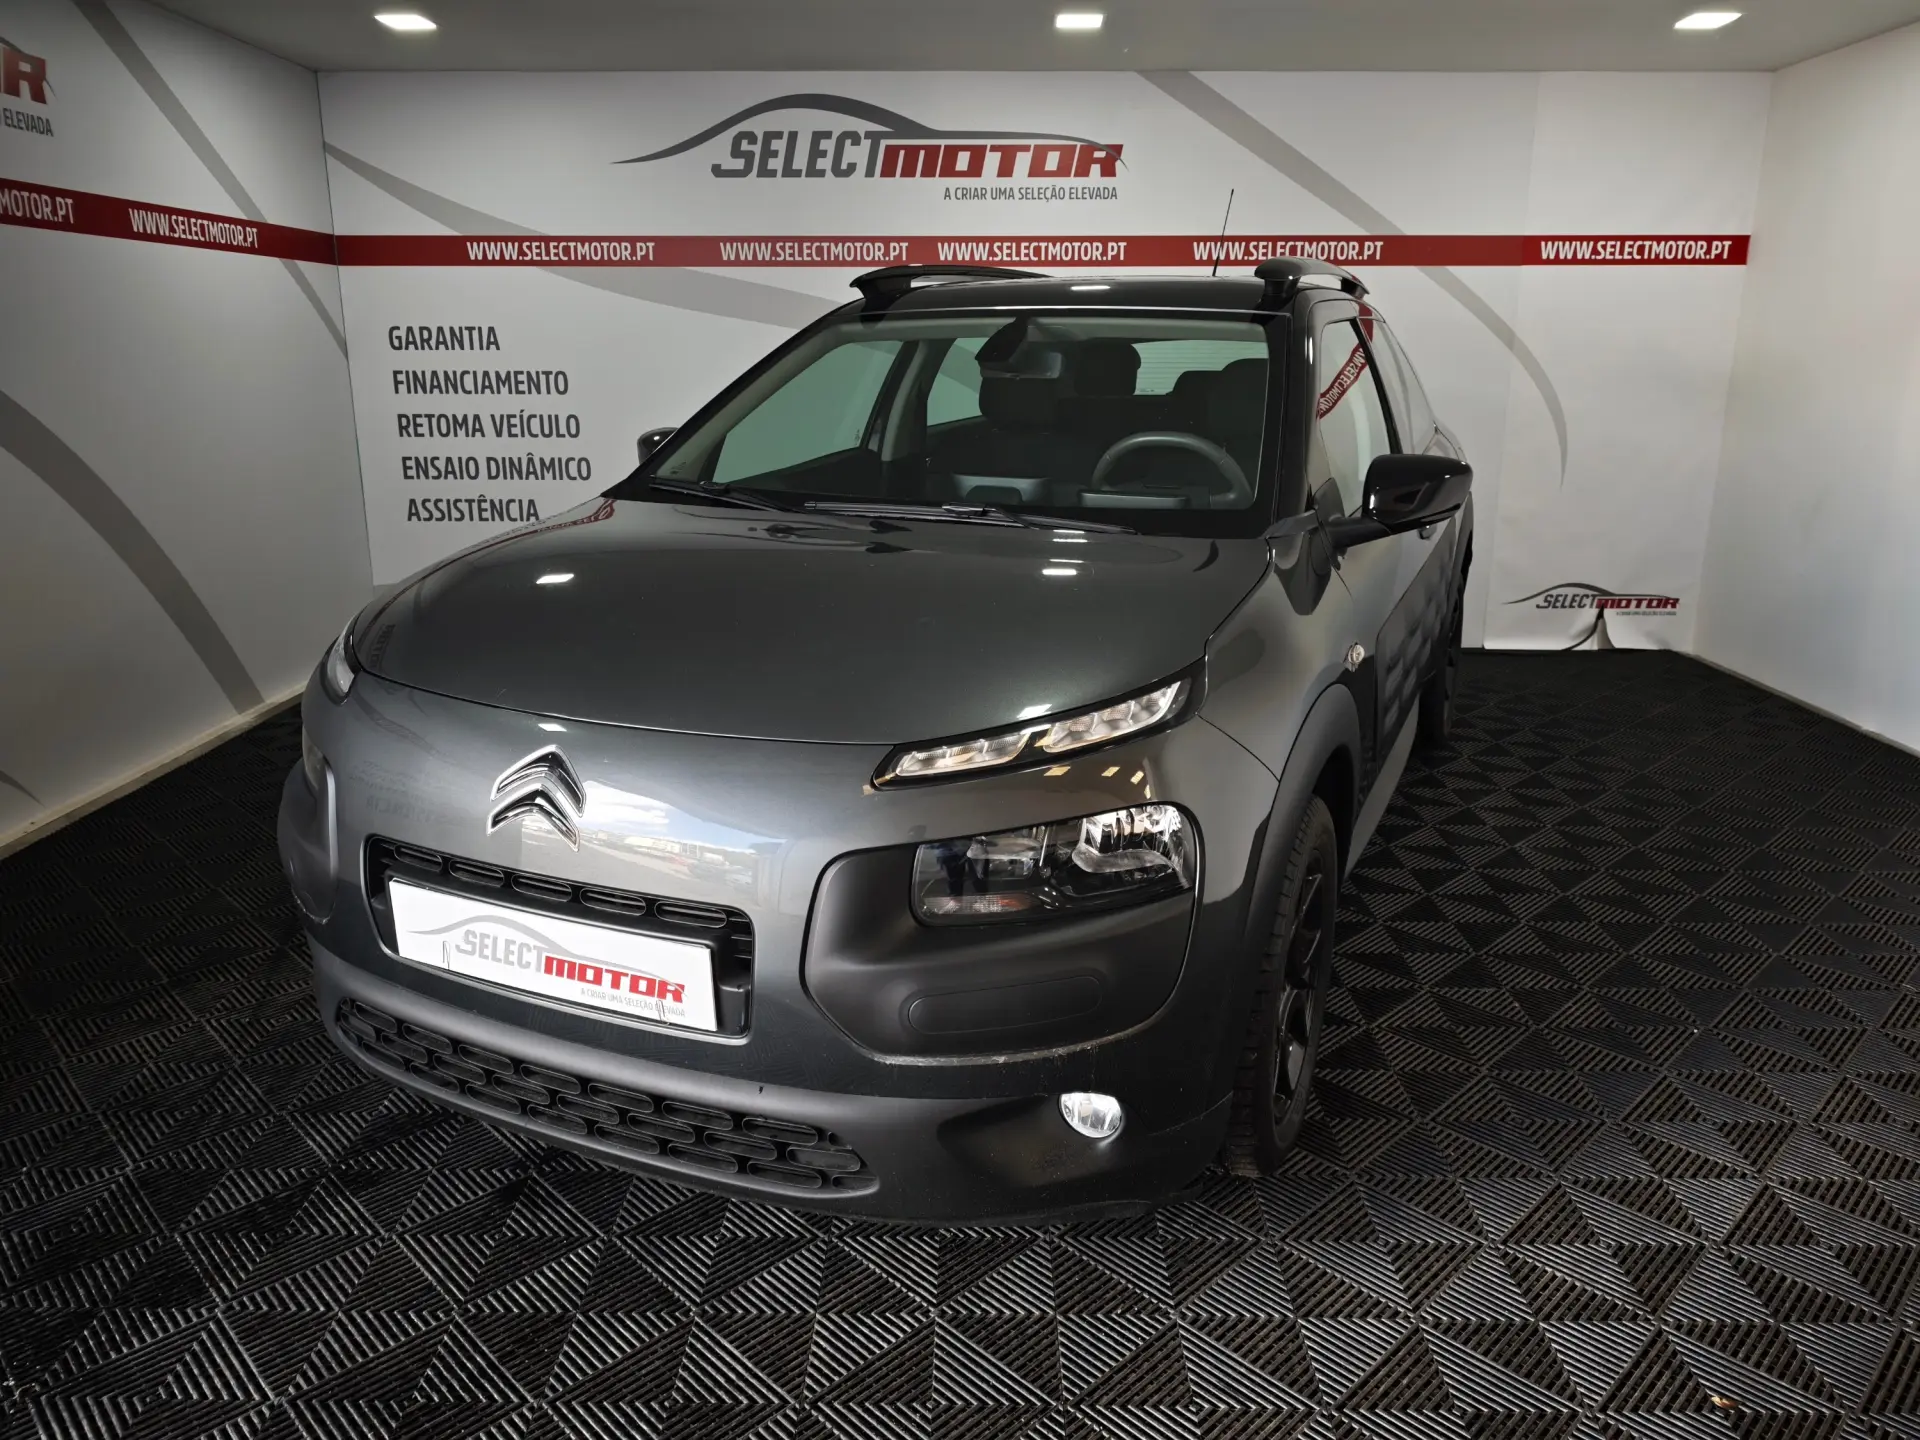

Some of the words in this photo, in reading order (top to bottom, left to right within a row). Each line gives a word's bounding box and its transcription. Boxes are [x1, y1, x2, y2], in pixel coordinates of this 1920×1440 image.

[3, 107, 54, 137] ELEVADA
[944, 187, 951, 200] A
[955, 187, 987, 200] CRIAR
[990, 187, 1015, 200] UMA
[1018, 185, 1065, 202] SELEÇÃO
[1069, 187, 1117, 200] ELEVADA
[129, 208, 258, 249] WWW.SELECTMOTOR.PT
[466, 241, 656, 261] WWW.SELECTMOTOR.PT
[719, 241, 909, 261] WWW.SELECTMOTOR.PT
[937, 241, 1127, 261] WWW.SELECTMOTOR.PT
[1193, 241, 1384, 260] WWW.SELECTMOTOR.PT
[1541, 241, 1732, 260] WWW.SELECTMOTOR.PT
[388, 326, 501, 351] GARANTIA
[392, 370, 569, 395] FINANCIAMENTO
[397, 413, 486, 438] RETOMA
[490, 409, 581, 439] VEÍCULO
[401, 456, 480, 480] ENSAIO
[486, 452, 592, 481] DINÂMICO
[407, 494, 540, 522] ASSISTÊNCIA
